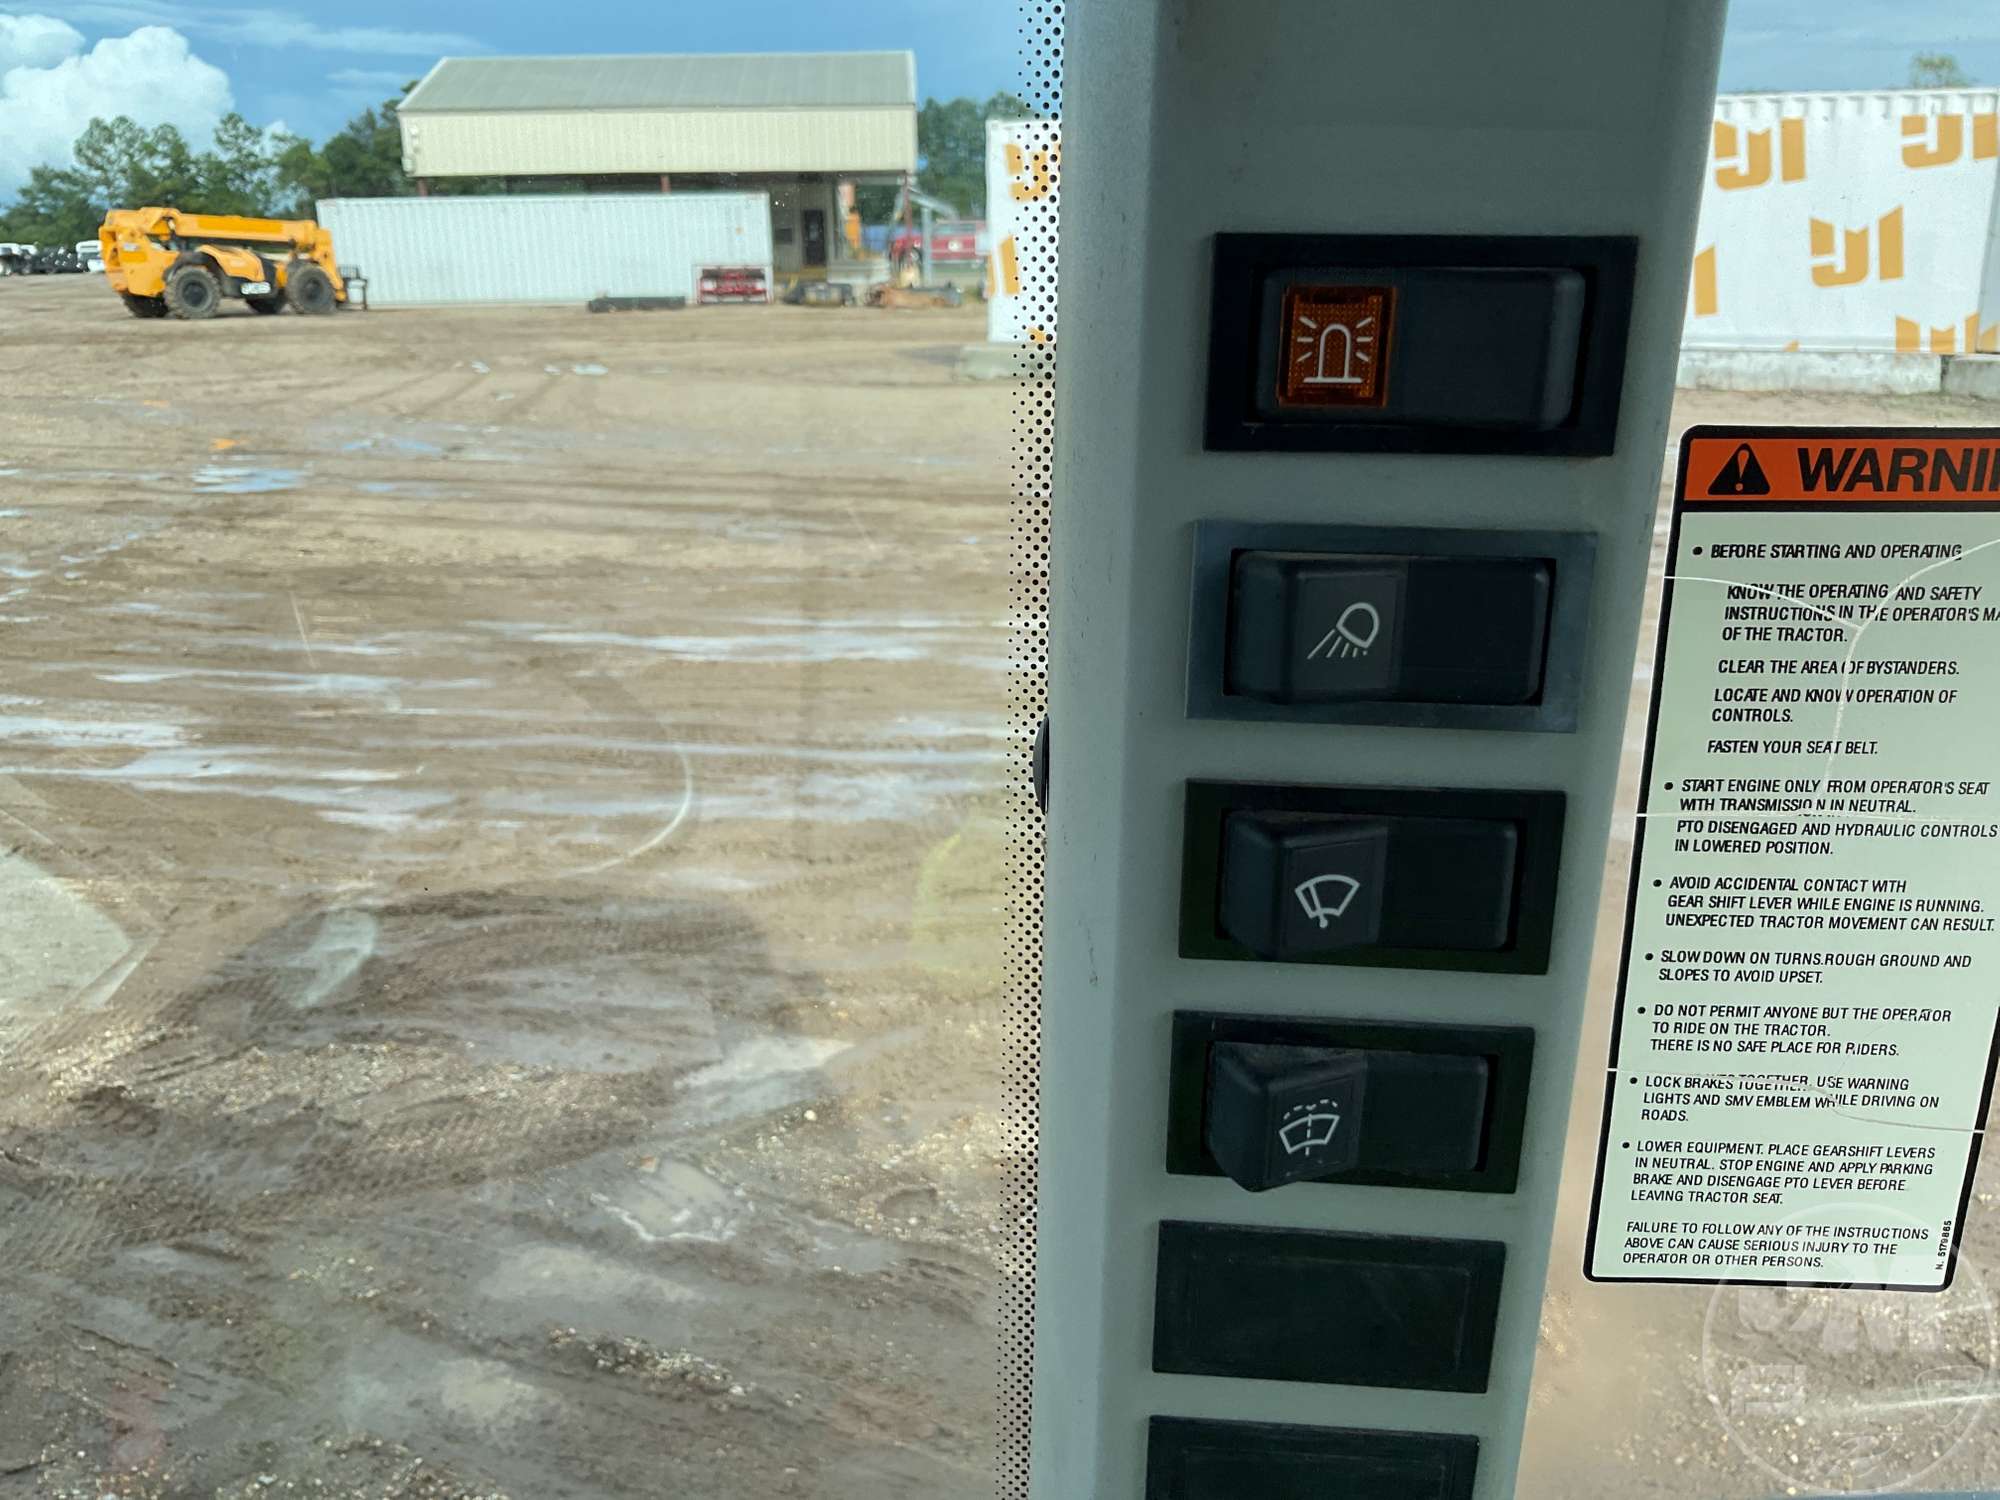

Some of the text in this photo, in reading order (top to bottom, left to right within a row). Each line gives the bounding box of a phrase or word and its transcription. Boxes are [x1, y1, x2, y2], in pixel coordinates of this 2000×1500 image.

[1797, 447, 2000, 492] WARNI
[1710, 543, 1962, 560] BEFORE STARTING AND OPERATING
[1727, 583, 1982, 600] KNOW THE OPERATING AND SAFETY
[1724, 605, 1835, 621] INSTRUCTIONS
[1838, 604, 1853, 618] IN
[1859, 605, 1889, 621] THE
[1892, 607, 1979, 621] OPERATOR'S
[1722, 626, 1847, 641] OF THE TRACTOR.
[1718, 659, 1764, 673] CLEAR
[1769, 659, 1797, 673] THE
[1800, 660, 1837, 673] AREA
[1866, 660, 1959, 674] BYSTANDERS.
[1714, 688, 1957, 703] LOCATE AND KNOW OPERATION OF
[1711, 708, 1792, 722] CONTROLS.
[1707, 740, 1877, 754] FASTEN YOUR SEAT BELT.
[1681, 778, 1990, 794] START ENGINE ONLY FROM OPERATOR'S SEAT
[1679, 798, 1915, 812] WITH TRANSMISSION IN NEUTRAL.
[1676, 819, 1997, 837] PTO DISENGAGED AND HYDRAULIC CONTROLS
[1674, 838, 1832, 854] IN LOWERED POSITION.
[1669, 876, 1906, 892] AVOID ACCIDENTAL CONTACT WITH
[1667, 894, 1983, 912] GEAR SHIFT LEVER WHILE ENGINE IS RUNNING.
[1665, 913, 1994, 931] UNEXPECTED TRACTOR MOVEMENT CAN RESULT.
[1660, 950, 1700, 962] SLOW
[1702, 950, 1745, 963] DOWN
[1749, 951, 1769, 964] ON
[1879, 954, 1939, 966] GROUND
[1943, 955, 1971, 967] AND
[1658, 968, 1822, 983] SLOPES TO AVOID UPSET.
[1653, 1004, 1951, 1021] DO NOT PERMIT ANYONE BUT THE OPERATOR
[1652, 1021, 1830, 1036] TO RIDE ON THE TRACTOR.
[1650, 1038, 1898, 1055] THERE IS NO SAFE PLACE FOR RIDERS.
[1645, 1075, 1681, 1087] LOCK
[1684, 1076, 1733, 1089] BRAKES
[1816, 1075, 1843, 1088] USE
[1847, 1077, 1908, 1090] WARNING
[1643, 1092, 1939, 1108] LIGHTS AND SMV EMBLEM WHILE DRIVING ON
[1641, 1108, 1688, 1121] ROADS.
[1637, 1140, 1935, 1158] LOWER EQUIPMENT. PLACE GEARSHIFT LEVERS
[1635, 1156, 1932, 1174] IN NEUTRAL. STOP ENGINE AND APPLY PARKING
[1633, 1173, 1906, 1190] BRAKE AND DISENGAGE PTO LEVER BEFORE
[1631, 1189, 1782, 1204] LEAVING TRACTOR SEAT.
[1626, 1221, 1928, 1239] FAILURE TO FOLLOW ANY OF THE INSTRUCTIONS
[1624, 1237, 1897, 1254] ABOVE CAN CAUSE SERIOUS INJURY TO THE
[1622, 1252, 1822, 1267] OPERATOR OR OTHER PERSONS.
